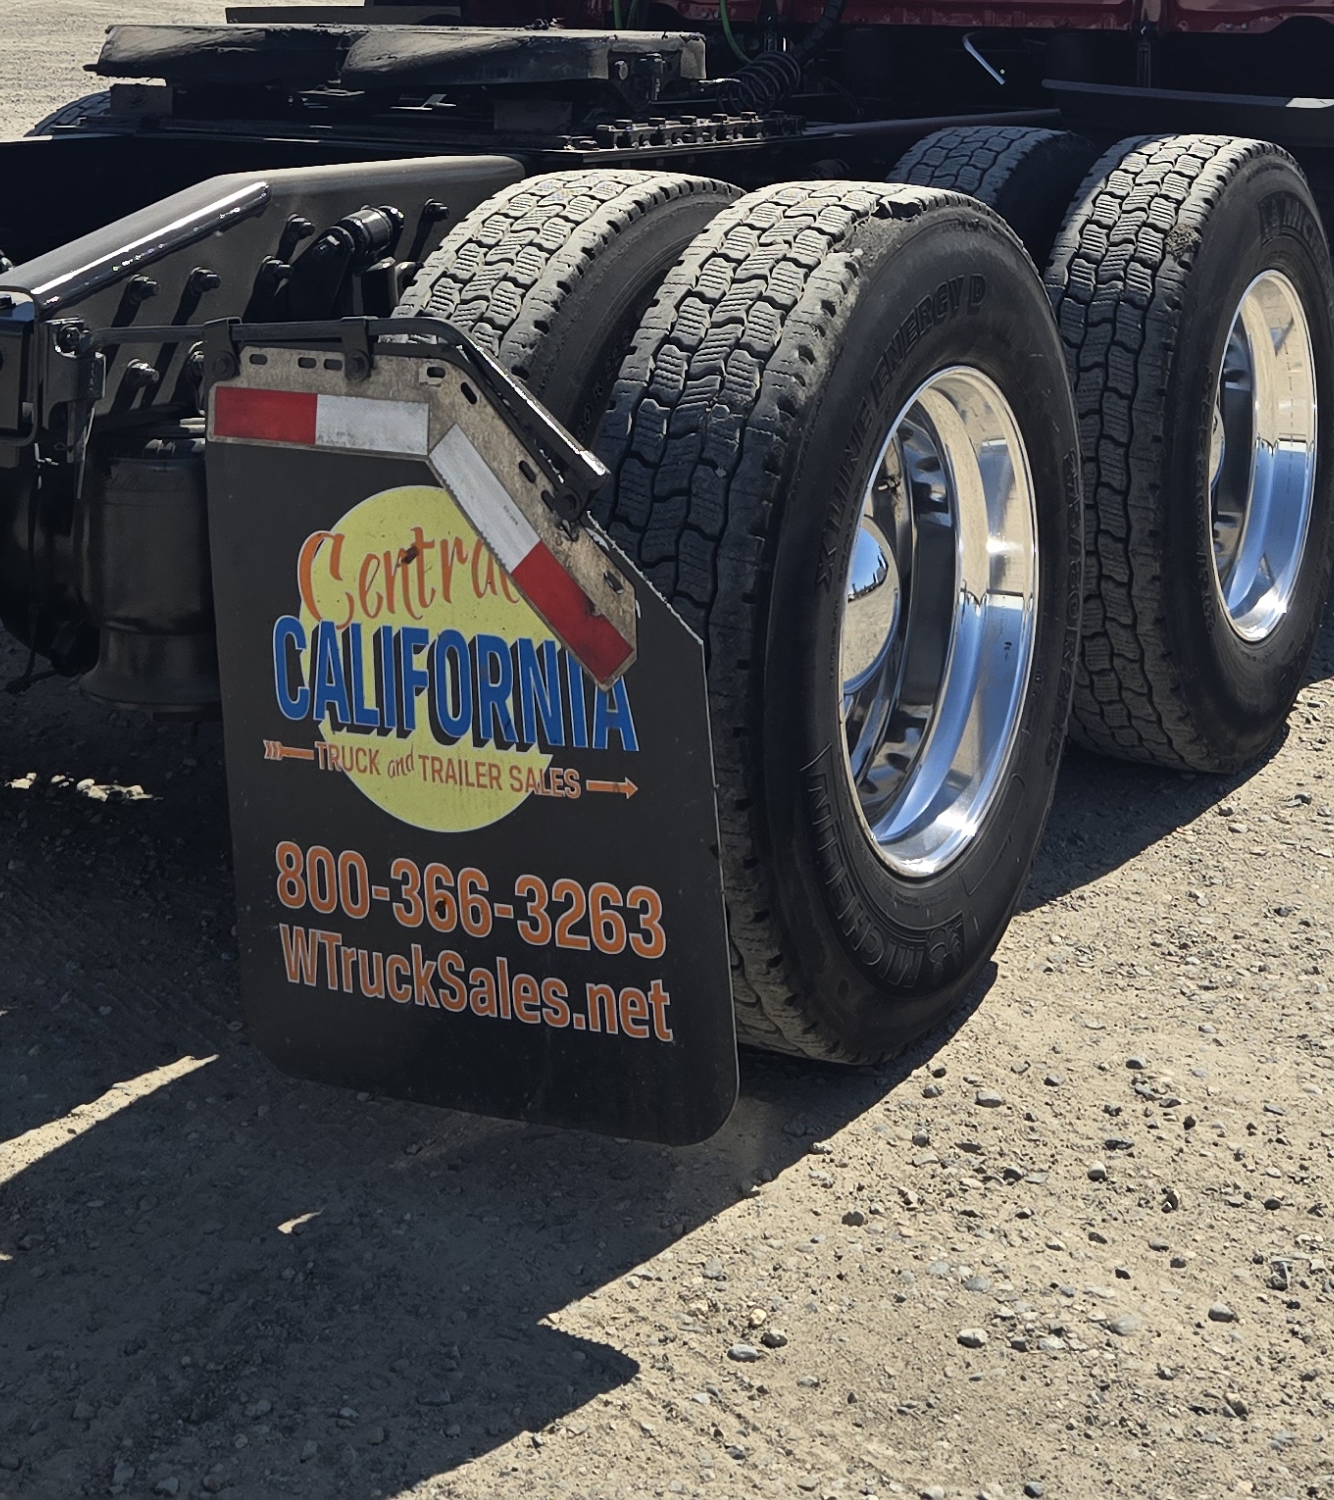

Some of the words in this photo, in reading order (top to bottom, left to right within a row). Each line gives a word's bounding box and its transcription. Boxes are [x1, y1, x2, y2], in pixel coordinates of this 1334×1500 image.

[870, 274, 965, 409] ENERGY
[968, 273, 987, 316] D
[273, 615, 640, 752] CALIFORNIA
[315, 741, 382, 776] TRUCK
[387, 744, 415, 779] and
[418, 753, 503, 790] TRAILER
[509, 764, 582, 799] SALES
[275, 840, 667, 959] 800-366-3263
[807, 770, 925, 988] MICHELIN
[279, 922, 674, 1042] WTruckSales.net
